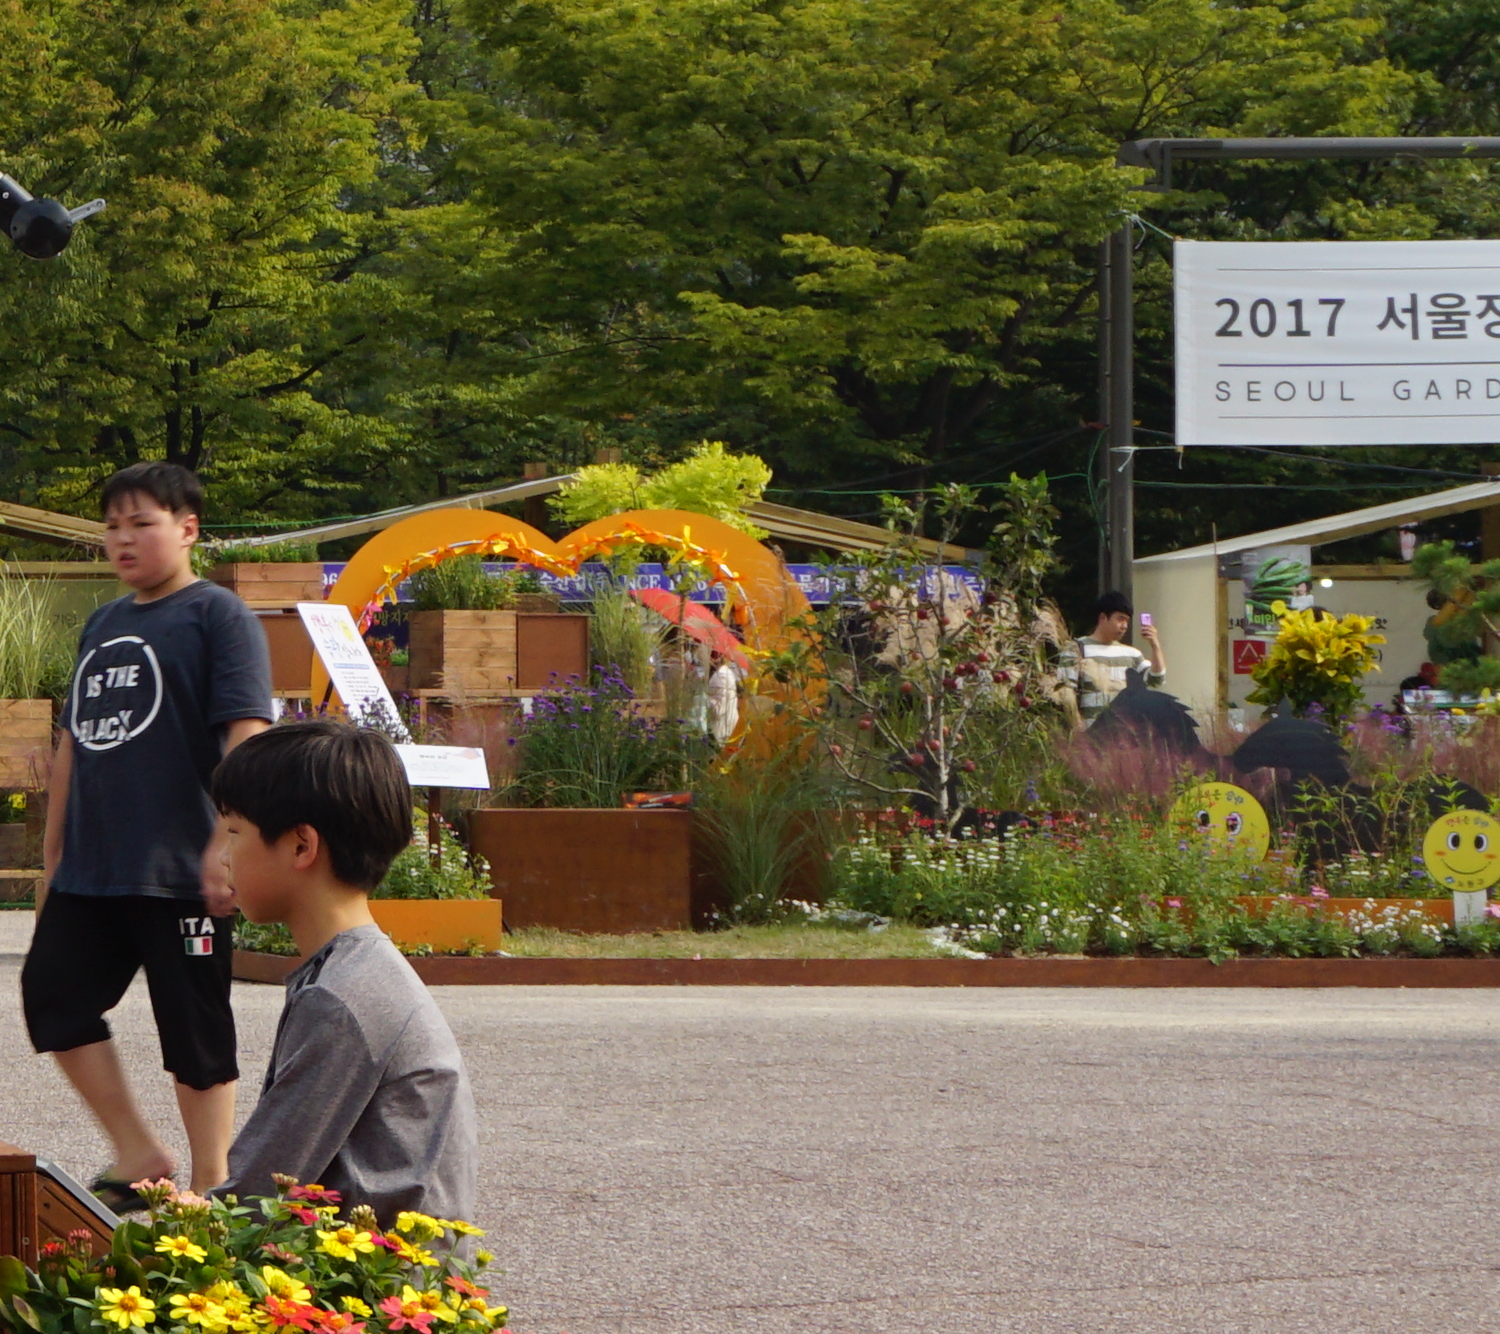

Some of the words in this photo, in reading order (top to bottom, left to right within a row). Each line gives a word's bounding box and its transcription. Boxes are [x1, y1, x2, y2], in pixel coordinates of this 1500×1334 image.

[1214, 298, 1346, 338] 2017
[1214, 380, 1355, 402] SEOUL
[105, 664, 141, 688] THE
[178, 917, 216, 936] ITA
